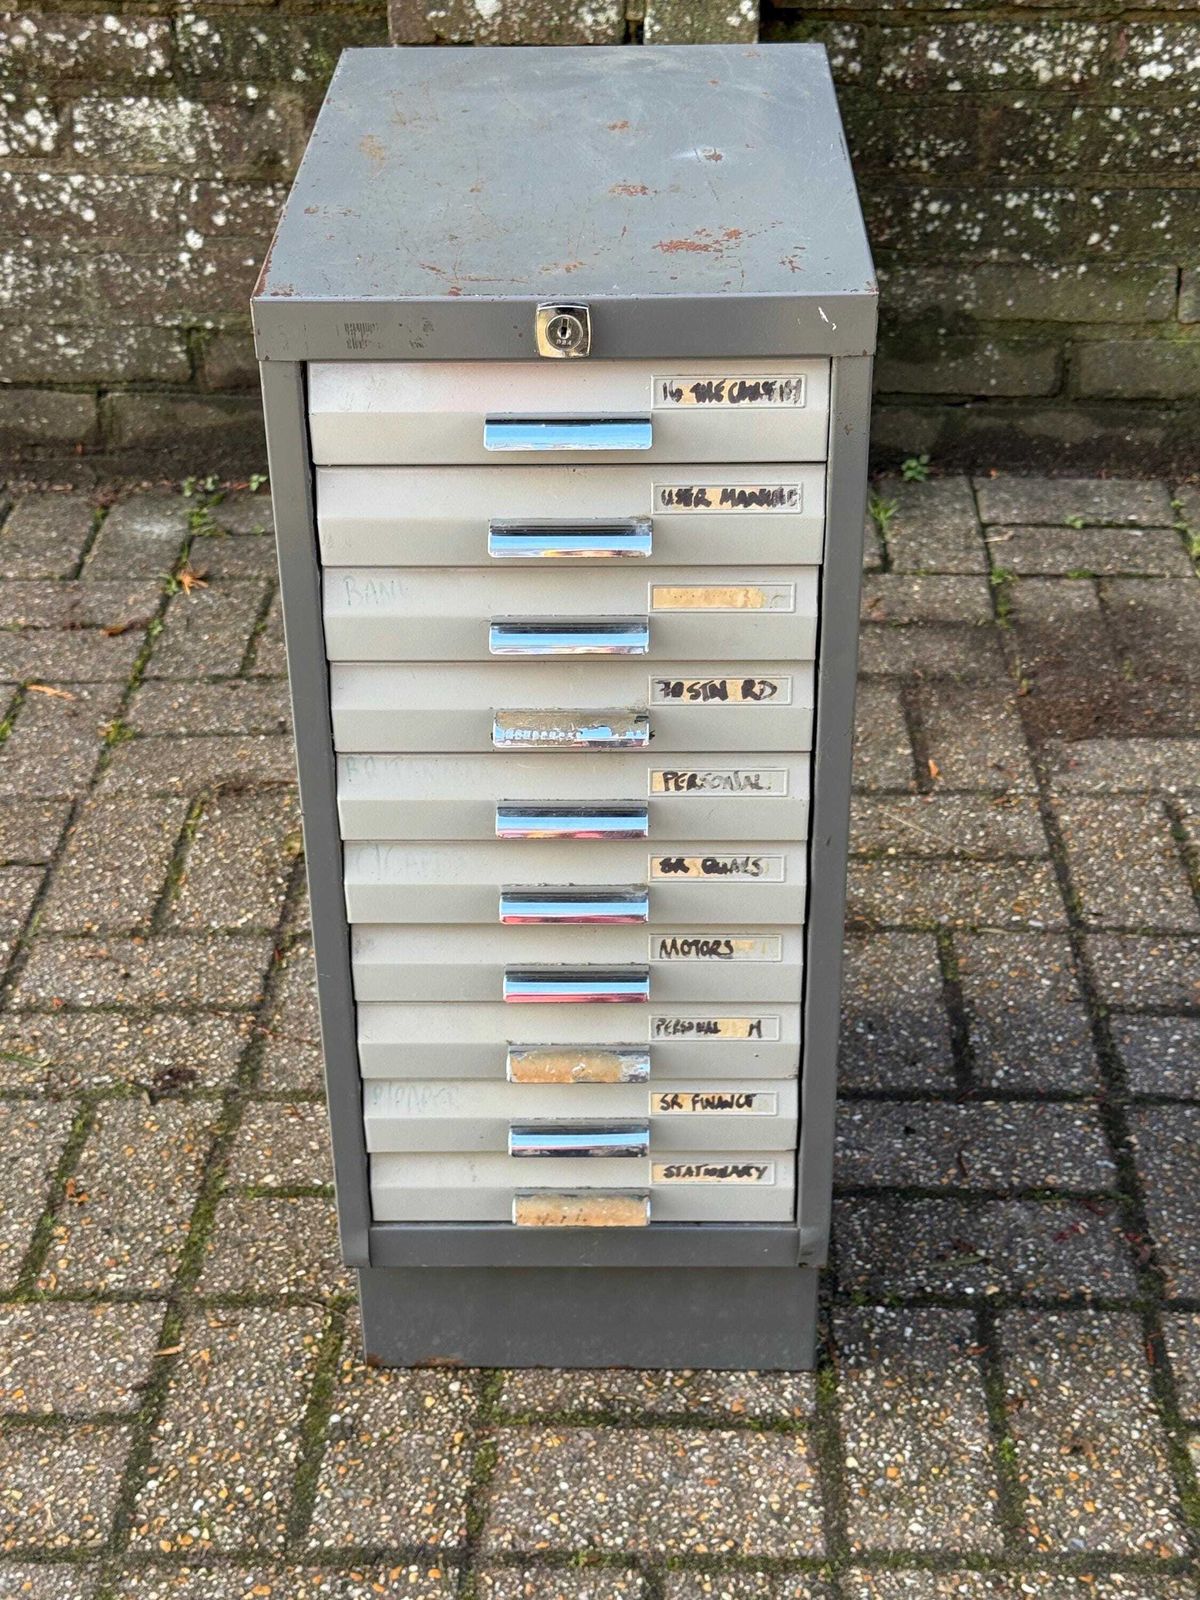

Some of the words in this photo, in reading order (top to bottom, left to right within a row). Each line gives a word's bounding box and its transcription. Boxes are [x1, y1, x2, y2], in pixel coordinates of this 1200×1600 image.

[660, 485, 713, 508] USER
[659, 936, 736, 960] MOTORS
[659, 1093, 684, 1112] SR
[691, 1092, 758, 1112] FINANCE
